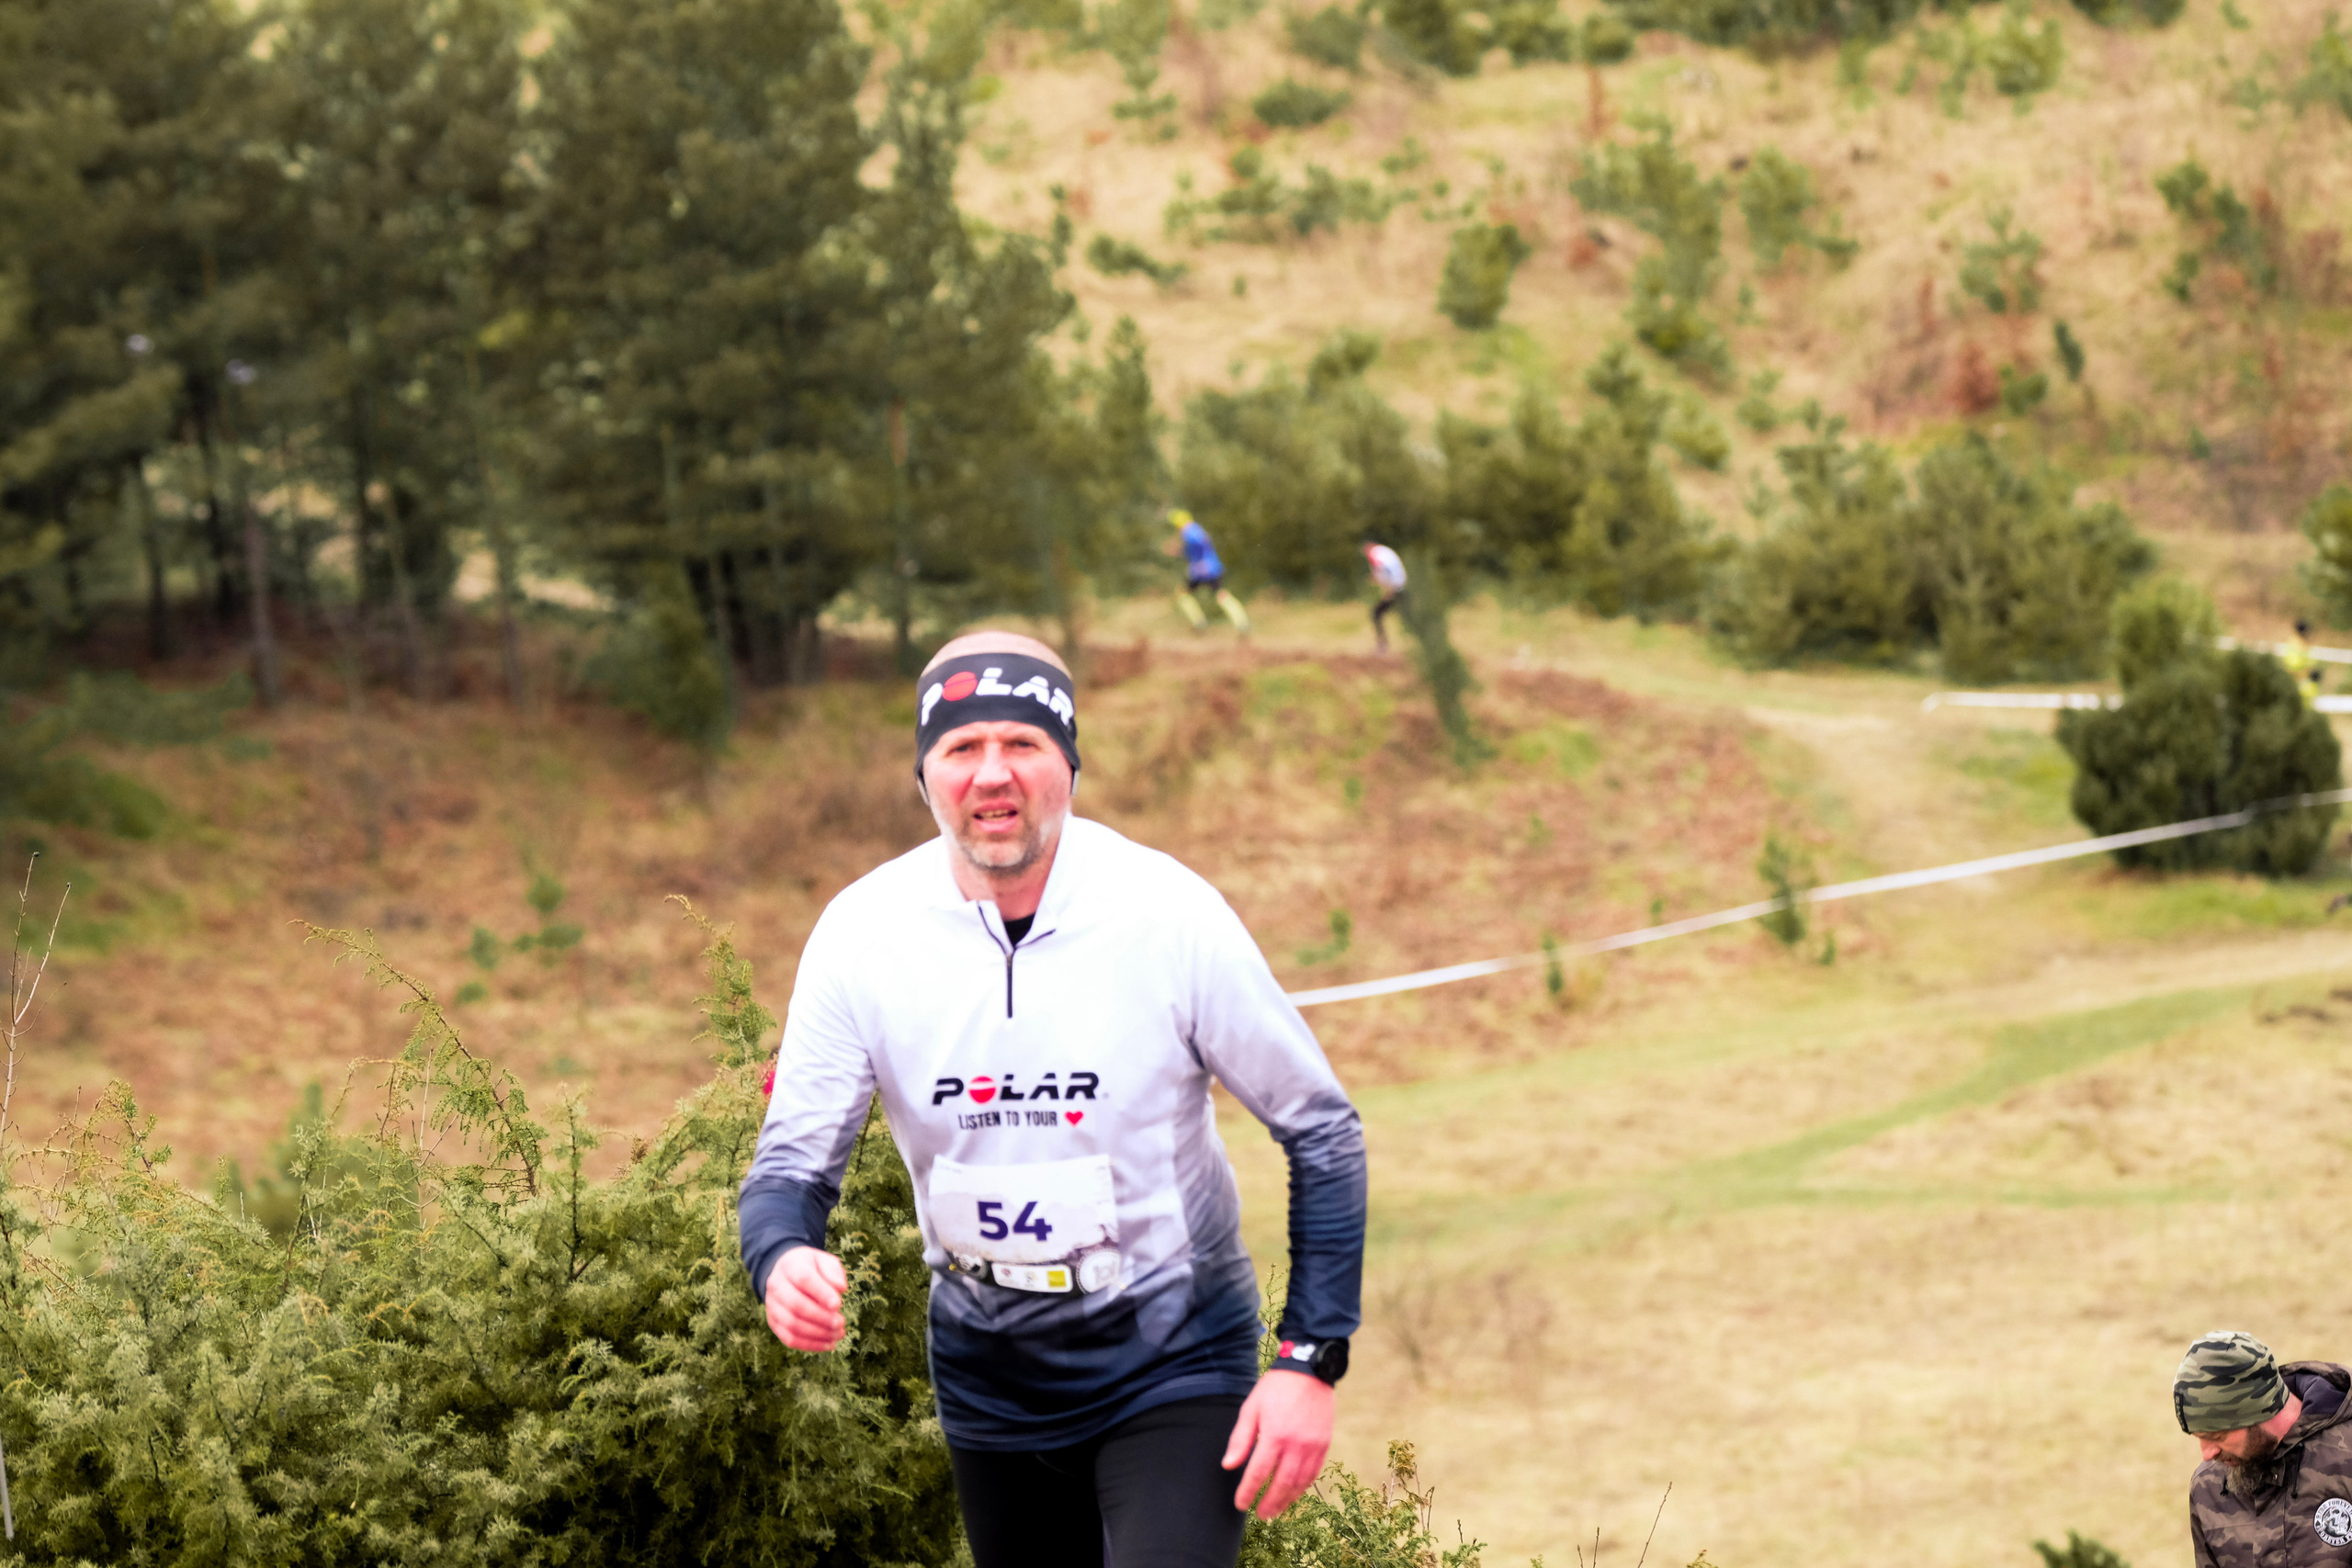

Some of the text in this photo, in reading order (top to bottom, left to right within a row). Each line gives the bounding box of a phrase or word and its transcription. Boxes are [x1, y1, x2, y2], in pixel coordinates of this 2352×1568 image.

[921, 667, 1074, 727] POLAR
[932, 1071, 1100, 1106] POLAR
[958, 1111, 1057, 1130] LISTEN TO YOUR
[977, 1201, 1053, 1242] 54
